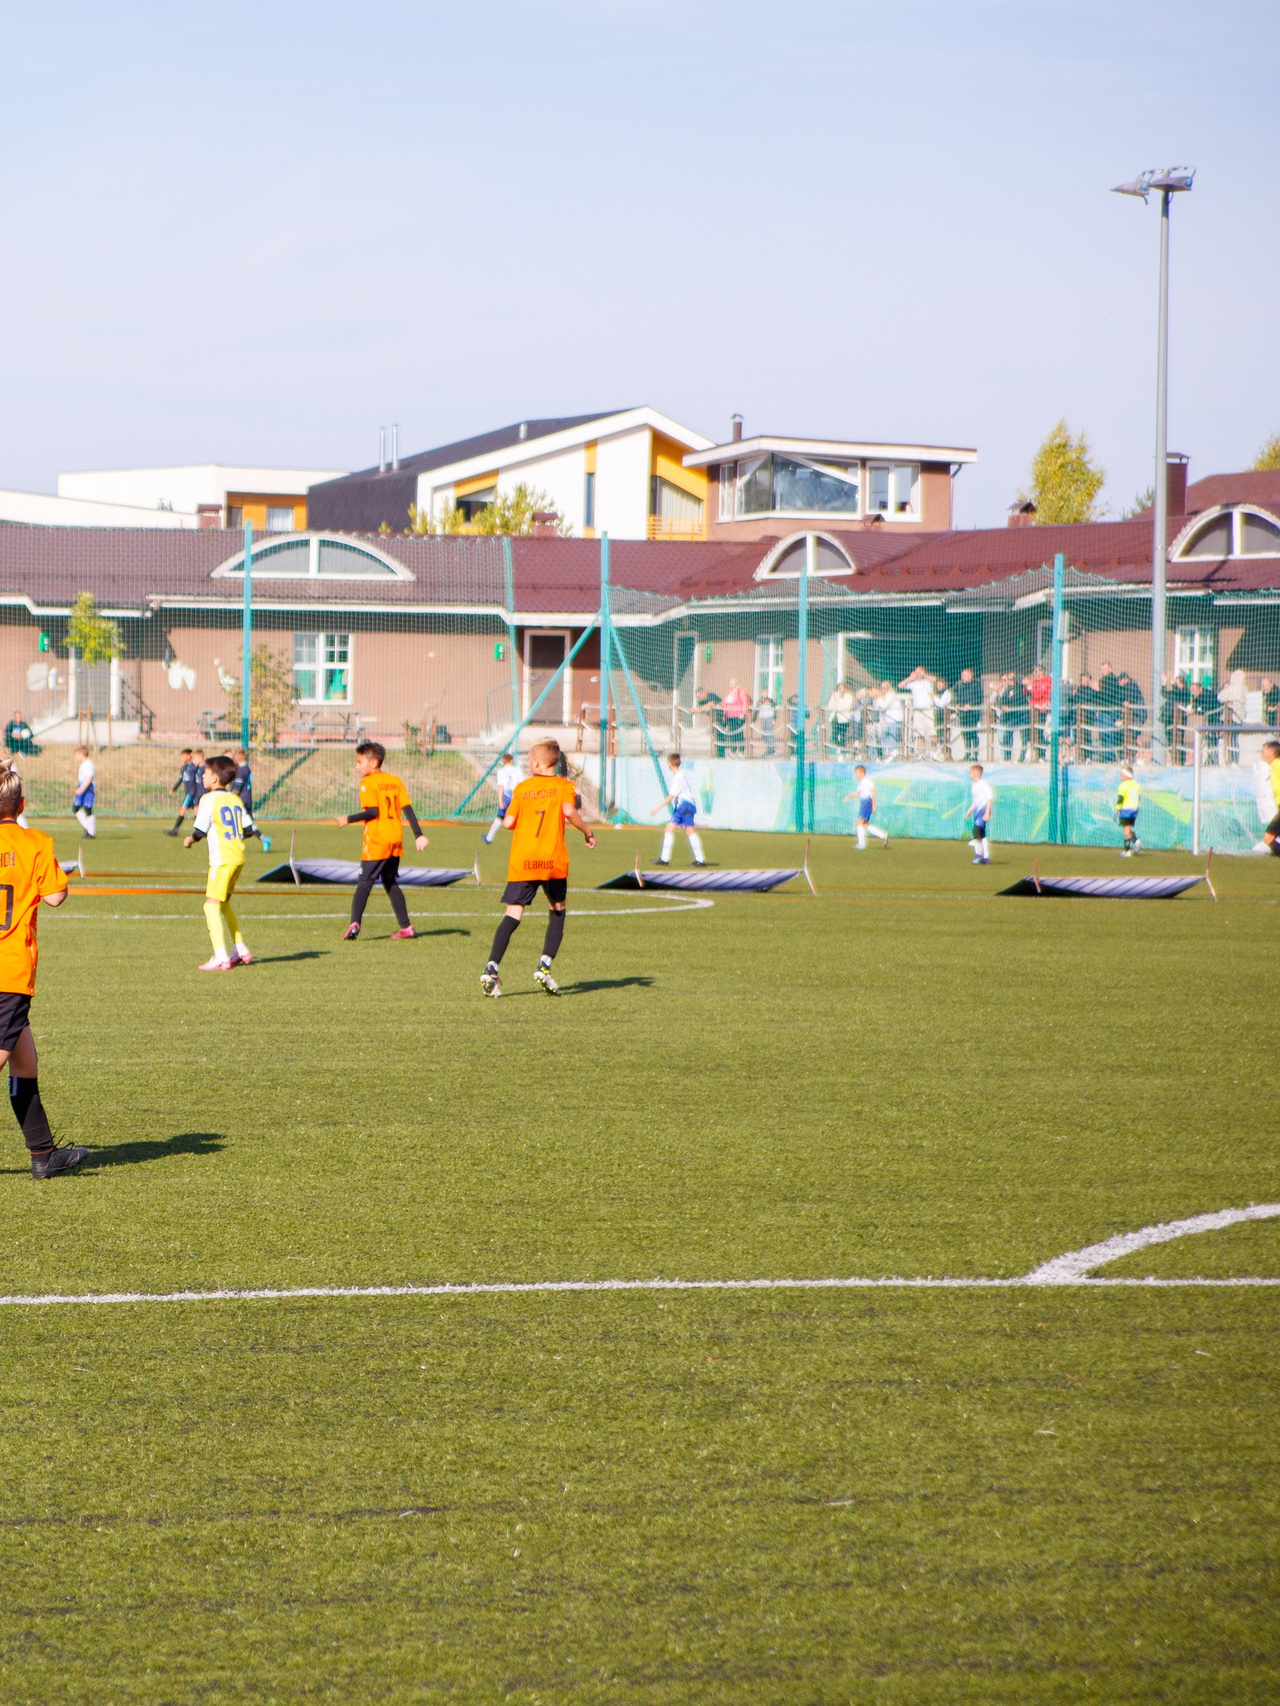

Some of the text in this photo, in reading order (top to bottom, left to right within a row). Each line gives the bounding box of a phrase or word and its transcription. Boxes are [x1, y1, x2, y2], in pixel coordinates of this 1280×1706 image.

[523, 787, 558, 801] АЛЕКСЕЕВ
[220, 805, 243, 840] 90
[535, 809, 546, 838] 7
[523, 860, 554, 870] ELBRUS
